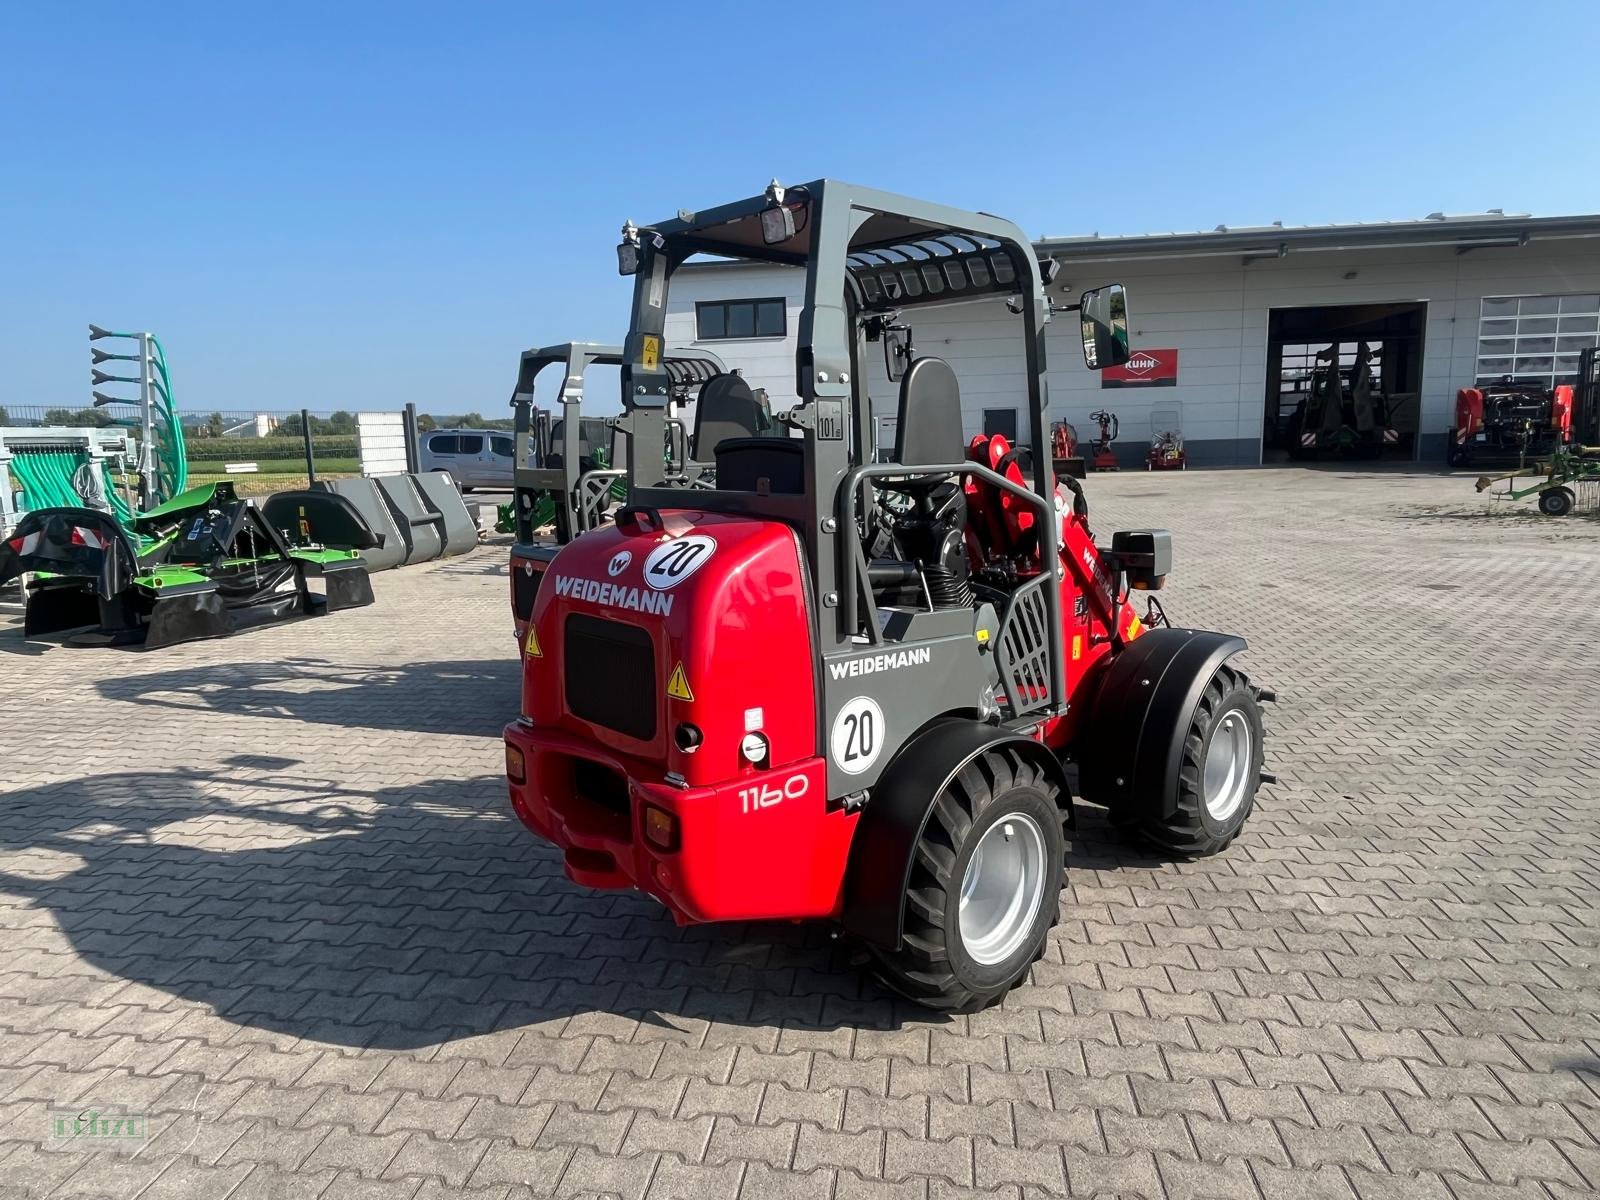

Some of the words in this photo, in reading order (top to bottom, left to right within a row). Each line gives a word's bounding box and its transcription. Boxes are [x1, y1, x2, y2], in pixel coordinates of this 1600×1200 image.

[1125, 360, 1155, 369] KUHN
[819, 417, 834, 438] 101
[650, 541, 706, 577] 20
[555, 575, 674, 617] WEIDEMANN
[829, 647, 931, 681] WEIDEMANN
[843, 709, 873, 762] 20
[738, 774, 809, 814] 1160
